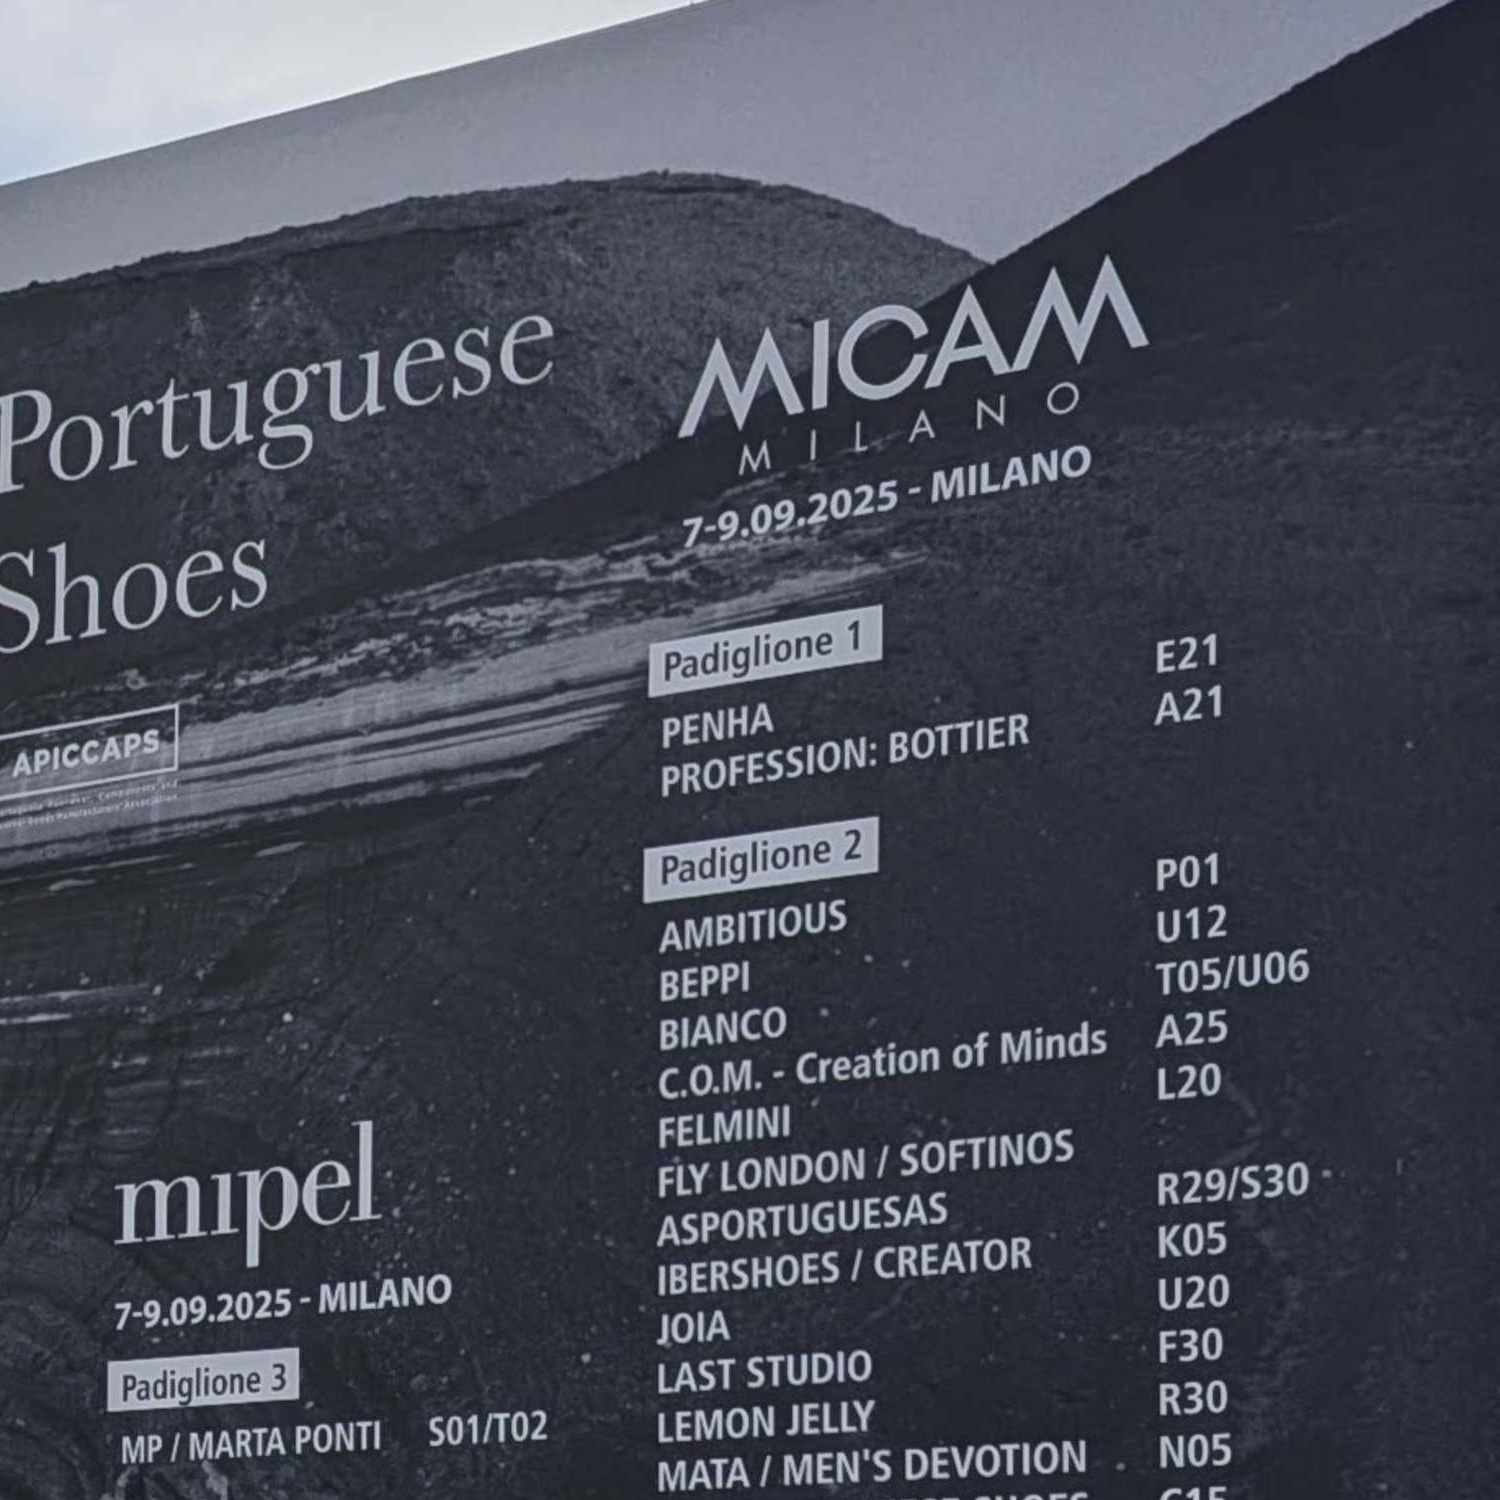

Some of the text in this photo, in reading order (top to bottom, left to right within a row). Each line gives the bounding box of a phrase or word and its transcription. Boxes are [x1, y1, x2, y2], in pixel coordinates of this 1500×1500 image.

[678, 255, 1149, 443] MICAM
[738, 381, 1081, 476] MILANO
[682, 479, 898, 552] 7-9.09.2025
[931, 445, 1092, 503] MILANO
[664, 620, 860, 682] Padiglione 1
[1156, 633, 1217, 674] E21
[662, 702, 774, 749] PENHA
[1154, 684, 1222, 726] A21
[12, 729, 159, 778] APICCAPS
[661, 713, 1029, 797] PROFESSION: BOTTIER
[661, 828, 862, 886] Padiglione 2
[1156, 852, 1218, 892] P01
[659, 899, 847, 954] AMBITIOUS
[1157, 904, 1227, 944] U12
[660, 960, 750, 1002] BEPPI
[1155, 948, 1310, 996] T05/U06
[659, 1006, 787, 1051] BIANCO
[1155, 1009, 1228, 1048] A25
[658, 1059, 762, 1100] C.O.M.
[796, 1035, 941, 1085] Creation
[952, 1031, 990, 1069] of
[1000, 1020, 1107, 1065] Minds
[1157, 1062, 1222, 1101] L20
[659, 1104, 790, 1149] FELMINI
[658, 1162, 710, 1198] FLY
[720, 1147, 865, 1192] LONDON
[900, 1128, 1074, 1177] SOFTINOS
[1158, 1161, 1309, 1206] R29/S30
[114, 1120, 382, 1268] mipel
[656, 1191, 948, 1247] ASPORTUGUESAS
[1158, 1221, 1227, 1259] K05
[658, 1250, 840, 1296] IBERSHOES
[874, 1236, 1032, 1279] CREATOR
[114, 1288, 292, 1331] 7-9.09.2025
[318, 1273, 452, 1314] MILANO
[1158, 1273, 1230, 1311] U20
[656, 1309, 731, 1346] JOIA
[1159, 1327, 1223, 1364] F30
[122, 1362, 287, 1403] Padiglione 3
[658, 1349, 872, 1394] LAST STUDIO
[1159, 1379, 1228, 1416] R30
[121, 1434, 163, 1465] MP
[189, 1426, 287, 1461] MARTA
[295, 1420, 381, 1455] PONTI
[429, 1409, 548, 1447] S01/T02
[658, 1399, 876, 1443] LEMON JELLY
[658, 1456, 751, 1492] MATA
[783, 1448, 892, 1486] MEN'S
[904, 1439, 1086, 1481] DEVOTION
[1159, 1432, 1232, 1469] N05
